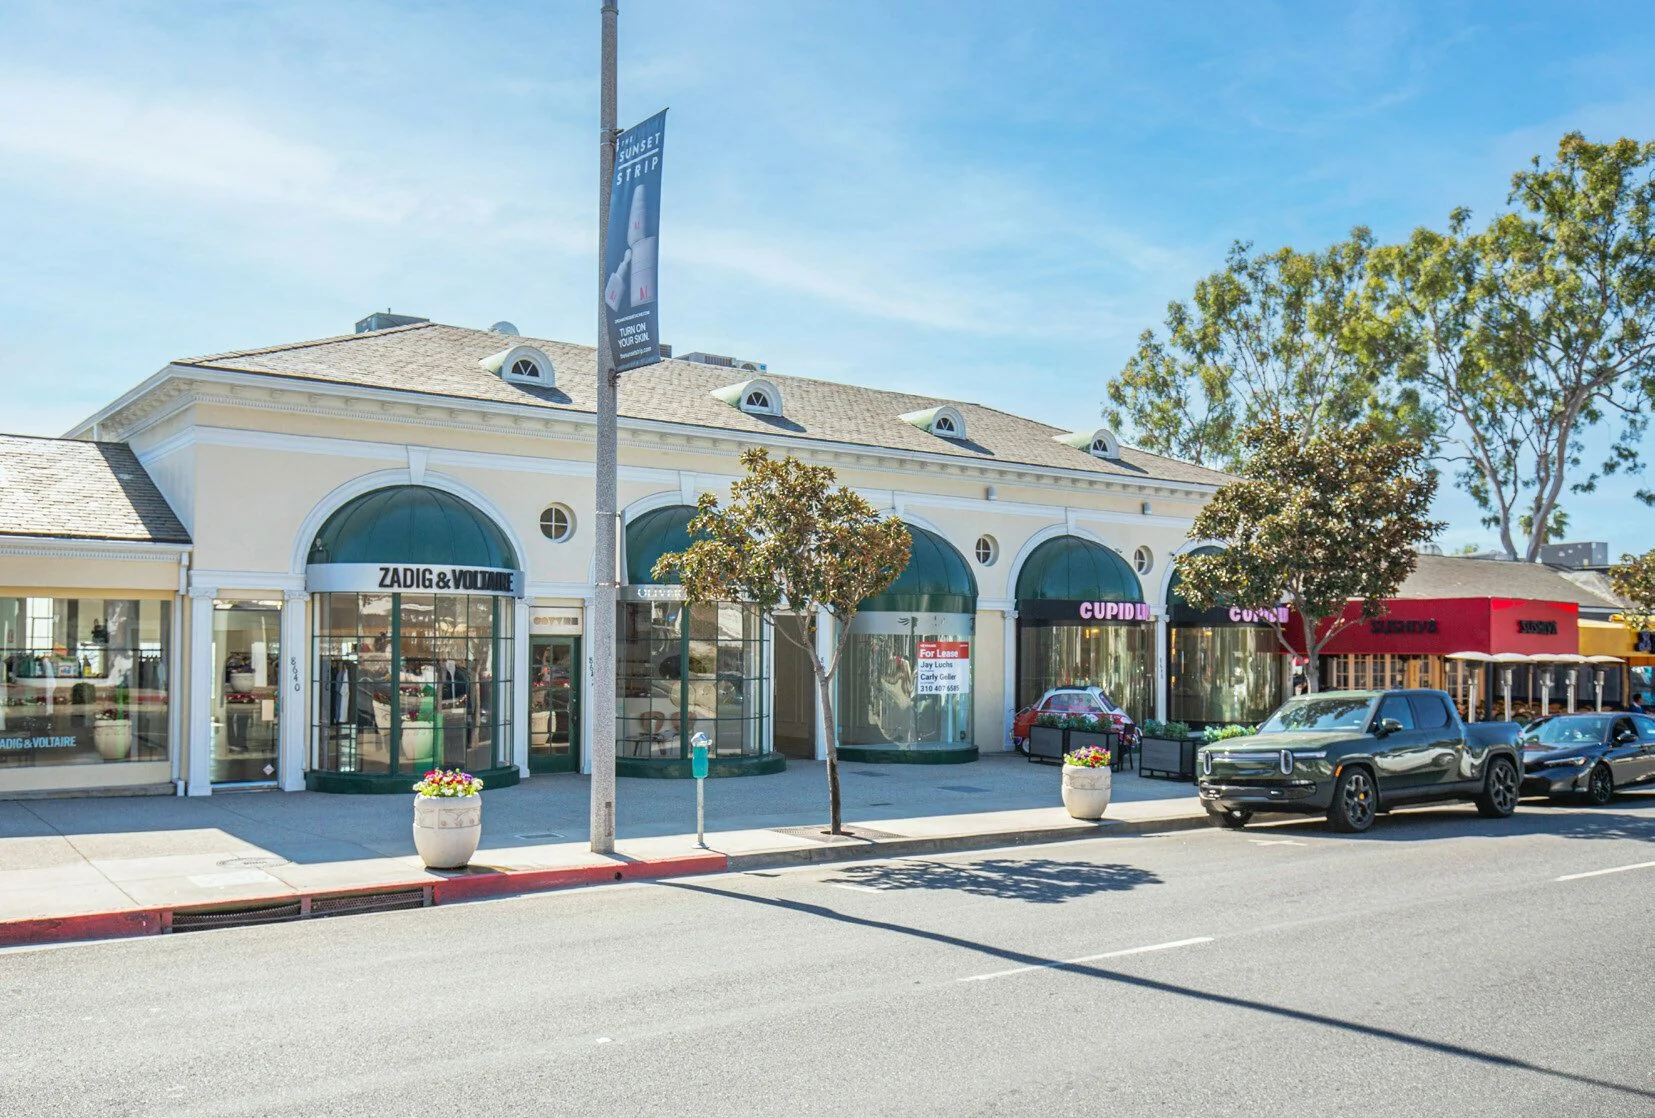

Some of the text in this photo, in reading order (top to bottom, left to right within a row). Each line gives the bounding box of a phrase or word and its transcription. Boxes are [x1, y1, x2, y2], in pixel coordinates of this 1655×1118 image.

[619, 132, 661, 162] SUNSET
[616, 156, 659, 186] STRIP
[619, 319, 647, 338] TURN ON
[617, 336, 635, 348] YOUR
[920, 649, 959, 658] For Lease
[920, 661, 934, 669] Jay
[920, 673, 938, 682] Carly
